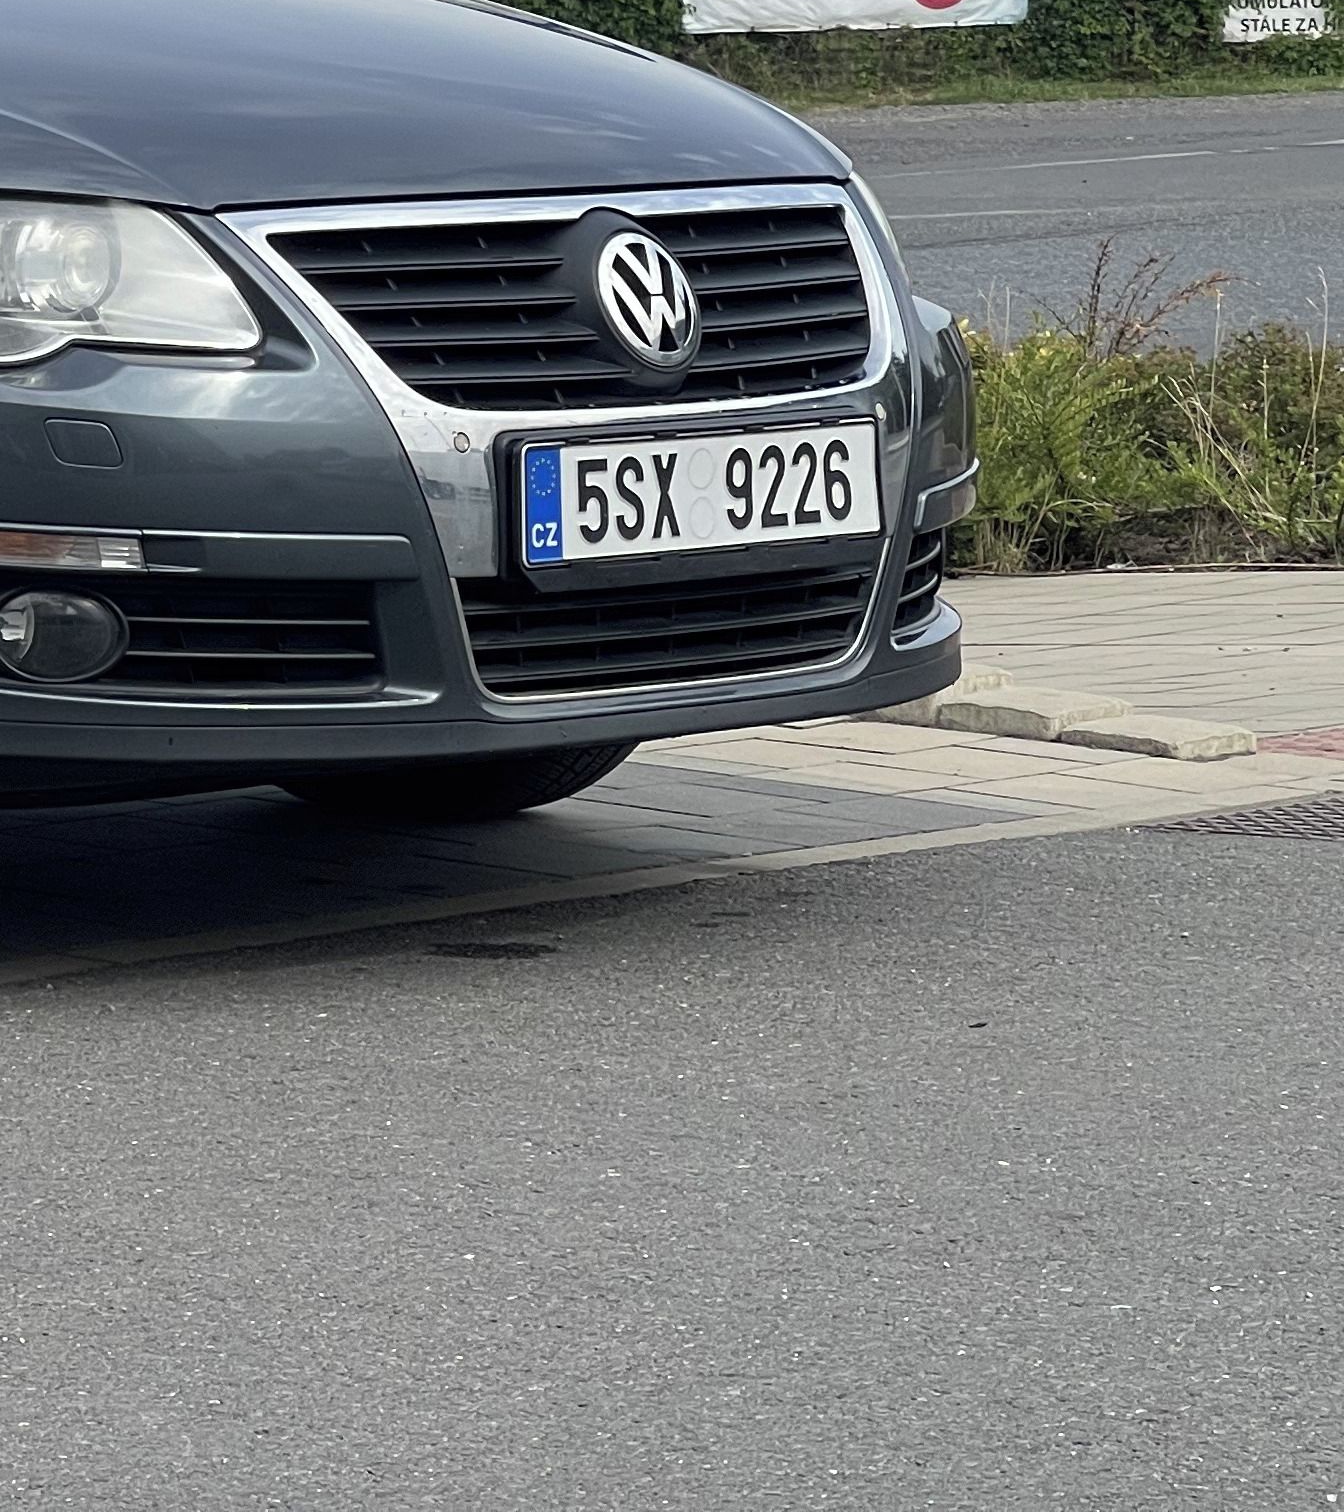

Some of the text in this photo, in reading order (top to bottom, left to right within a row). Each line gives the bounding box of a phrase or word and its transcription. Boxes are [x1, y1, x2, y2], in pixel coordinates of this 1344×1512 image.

[1240, 14, 1290, 32] STÁLE
[1295, 17, 1319, 32] ZA
[577, 439, 853, 543] 5SX 9226
[531, 522, 558, 548] CZ
